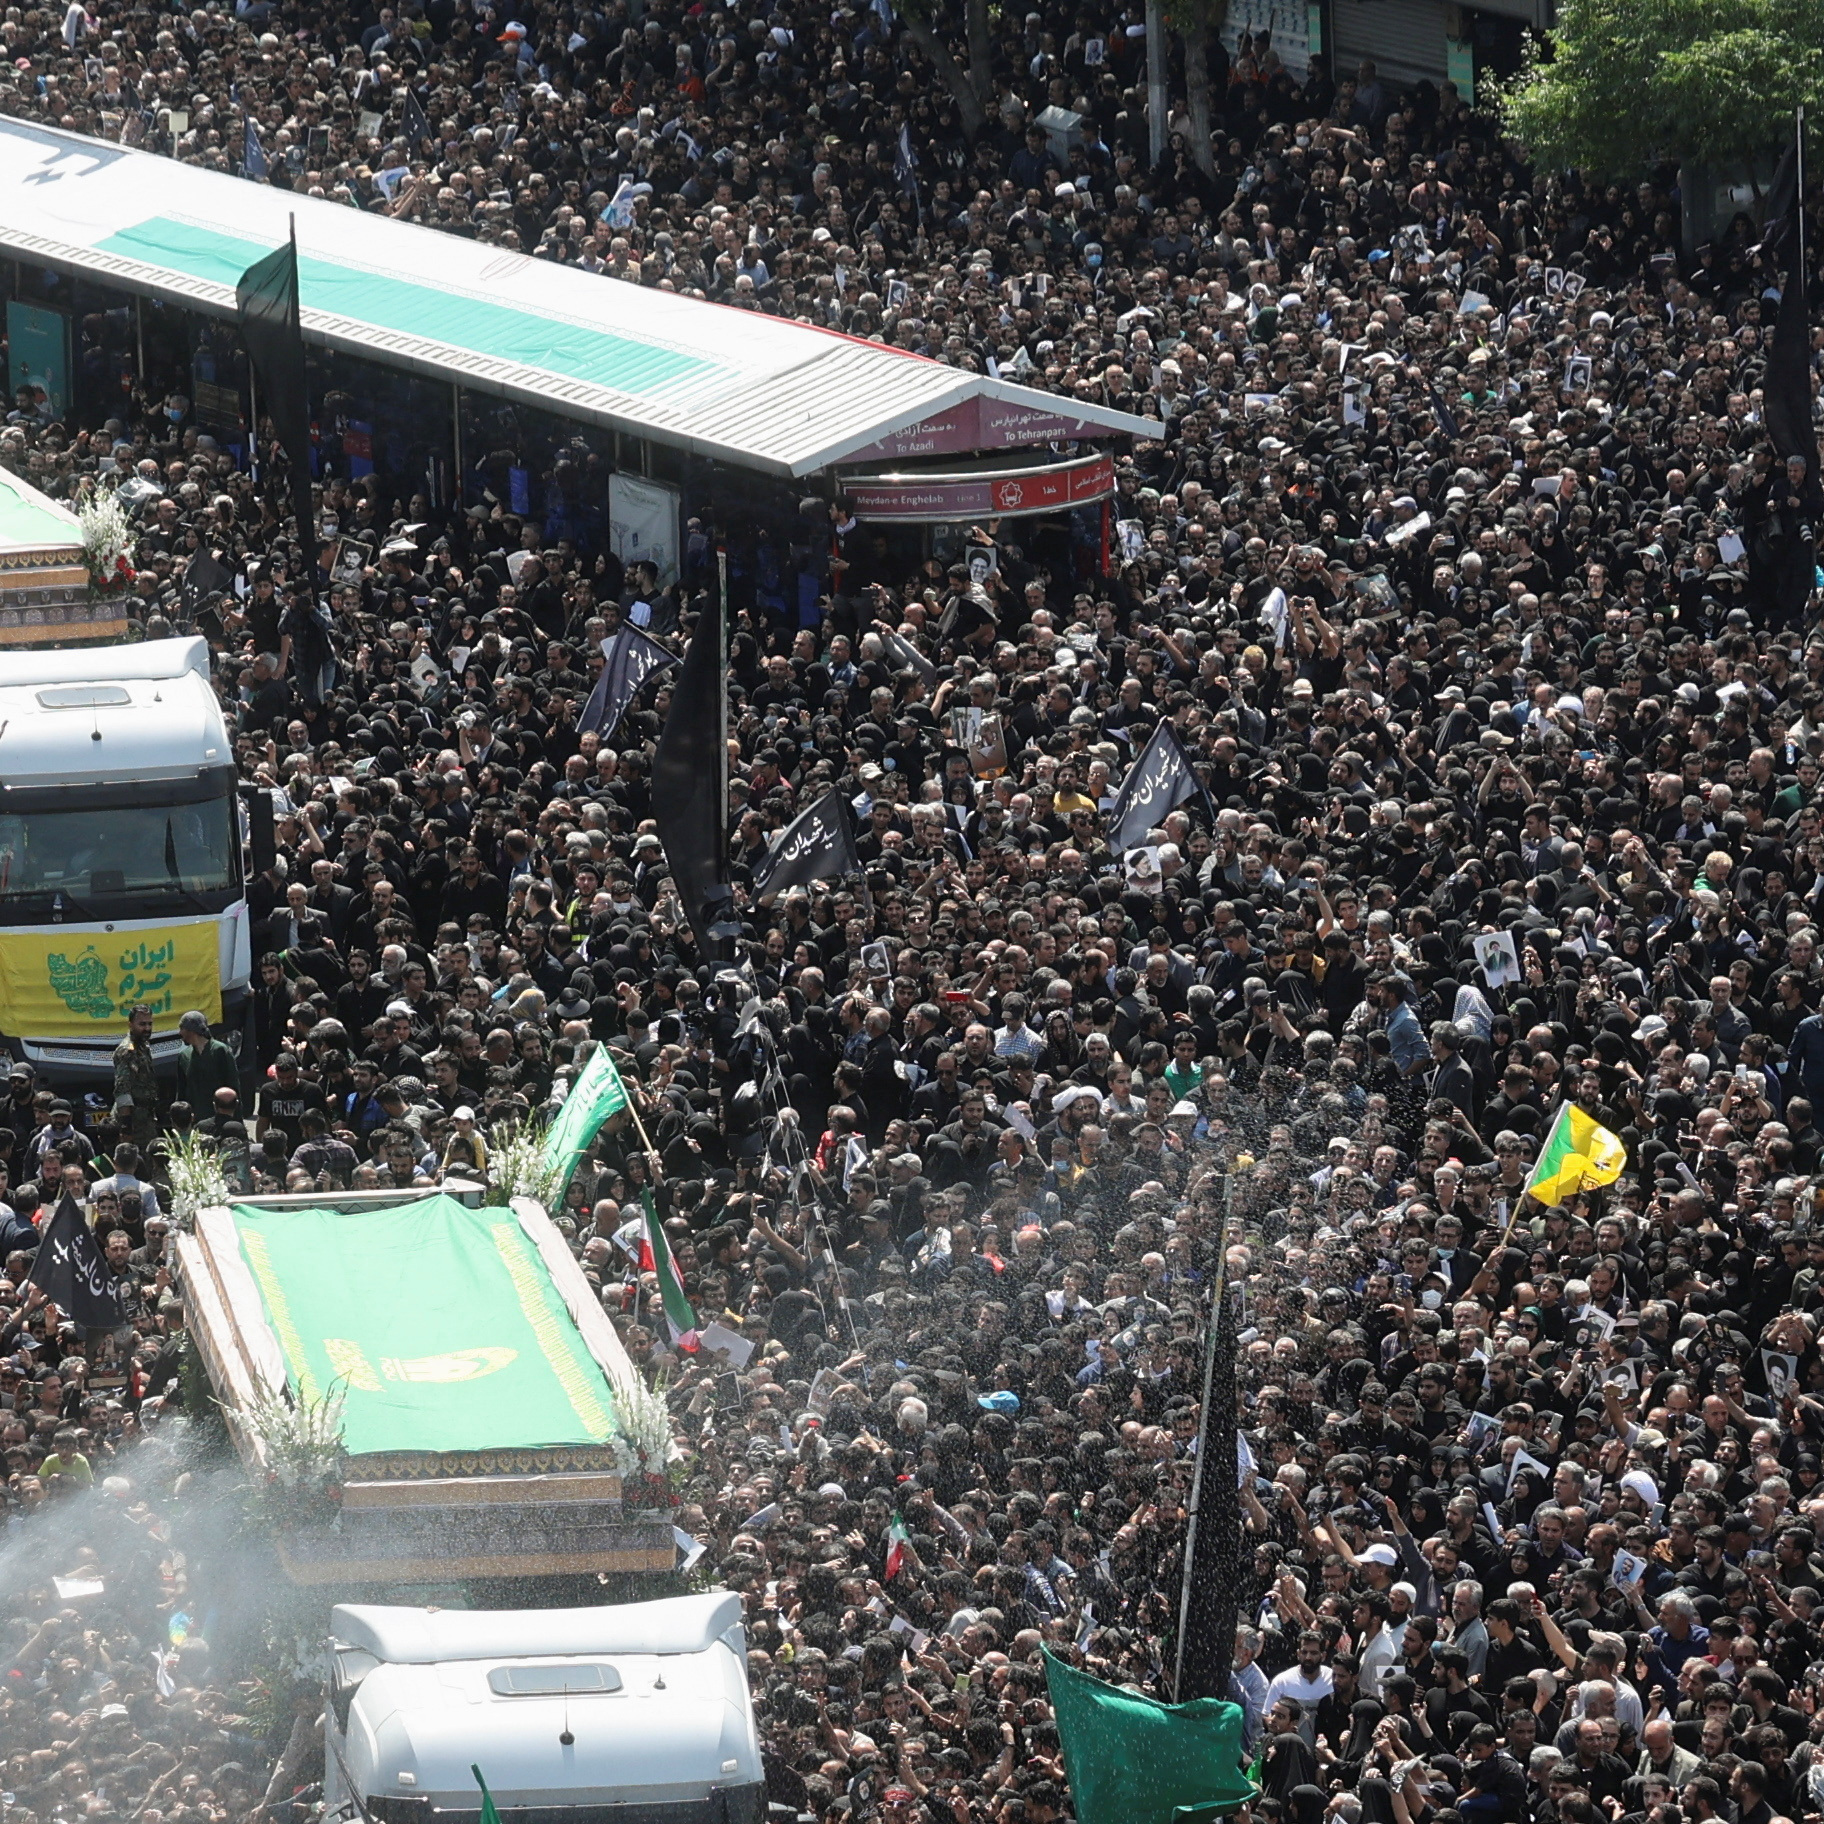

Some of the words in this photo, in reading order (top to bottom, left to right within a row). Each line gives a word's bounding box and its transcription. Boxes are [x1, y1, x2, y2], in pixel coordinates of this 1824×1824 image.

[1005, 431, 1016, 441] To
[1017, 427, 1067, 441] Tehranpars
[896, 444, 908, 453] To
[909, 440, 935, 452] Azadi
[901, 493, 944, 505] Enghelab
[784, 816, 825, 861] شهیدان
[819, 828, 838, 850] سید
[119, 940, 174, 970] ایران
[118, 972, 173, 998] حرم
